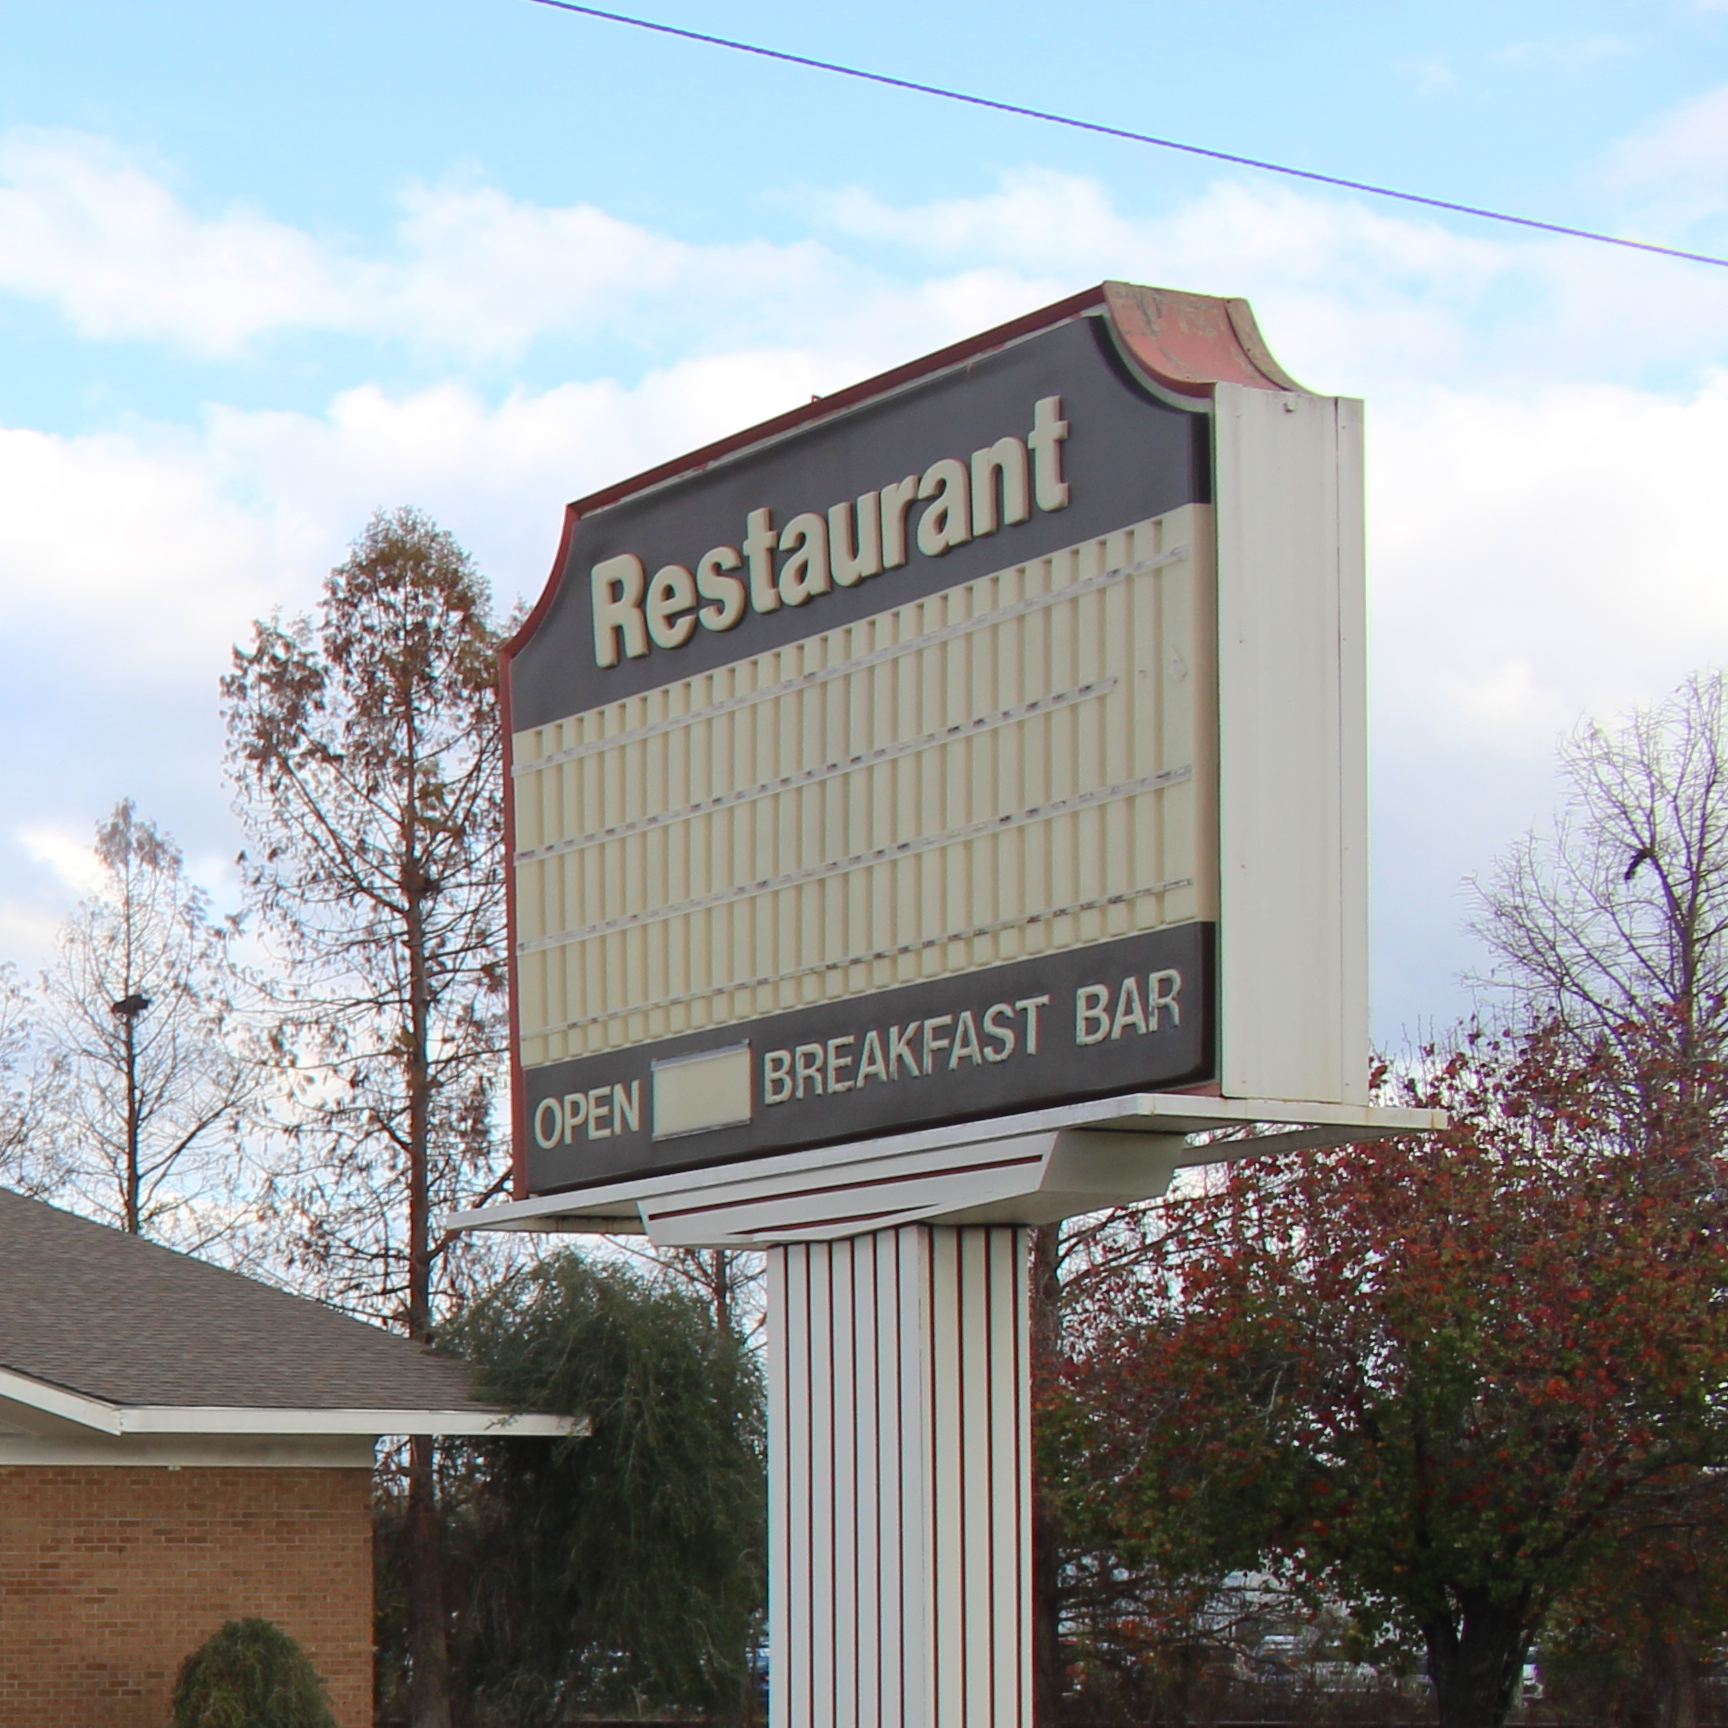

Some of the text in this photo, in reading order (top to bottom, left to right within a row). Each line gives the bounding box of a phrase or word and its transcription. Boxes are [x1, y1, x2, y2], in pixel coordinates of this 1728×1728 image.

[590, 395, 1072, 669] Restaurant
[534, 967, 1183, 1151] OPEN BREAKFAST BAR
